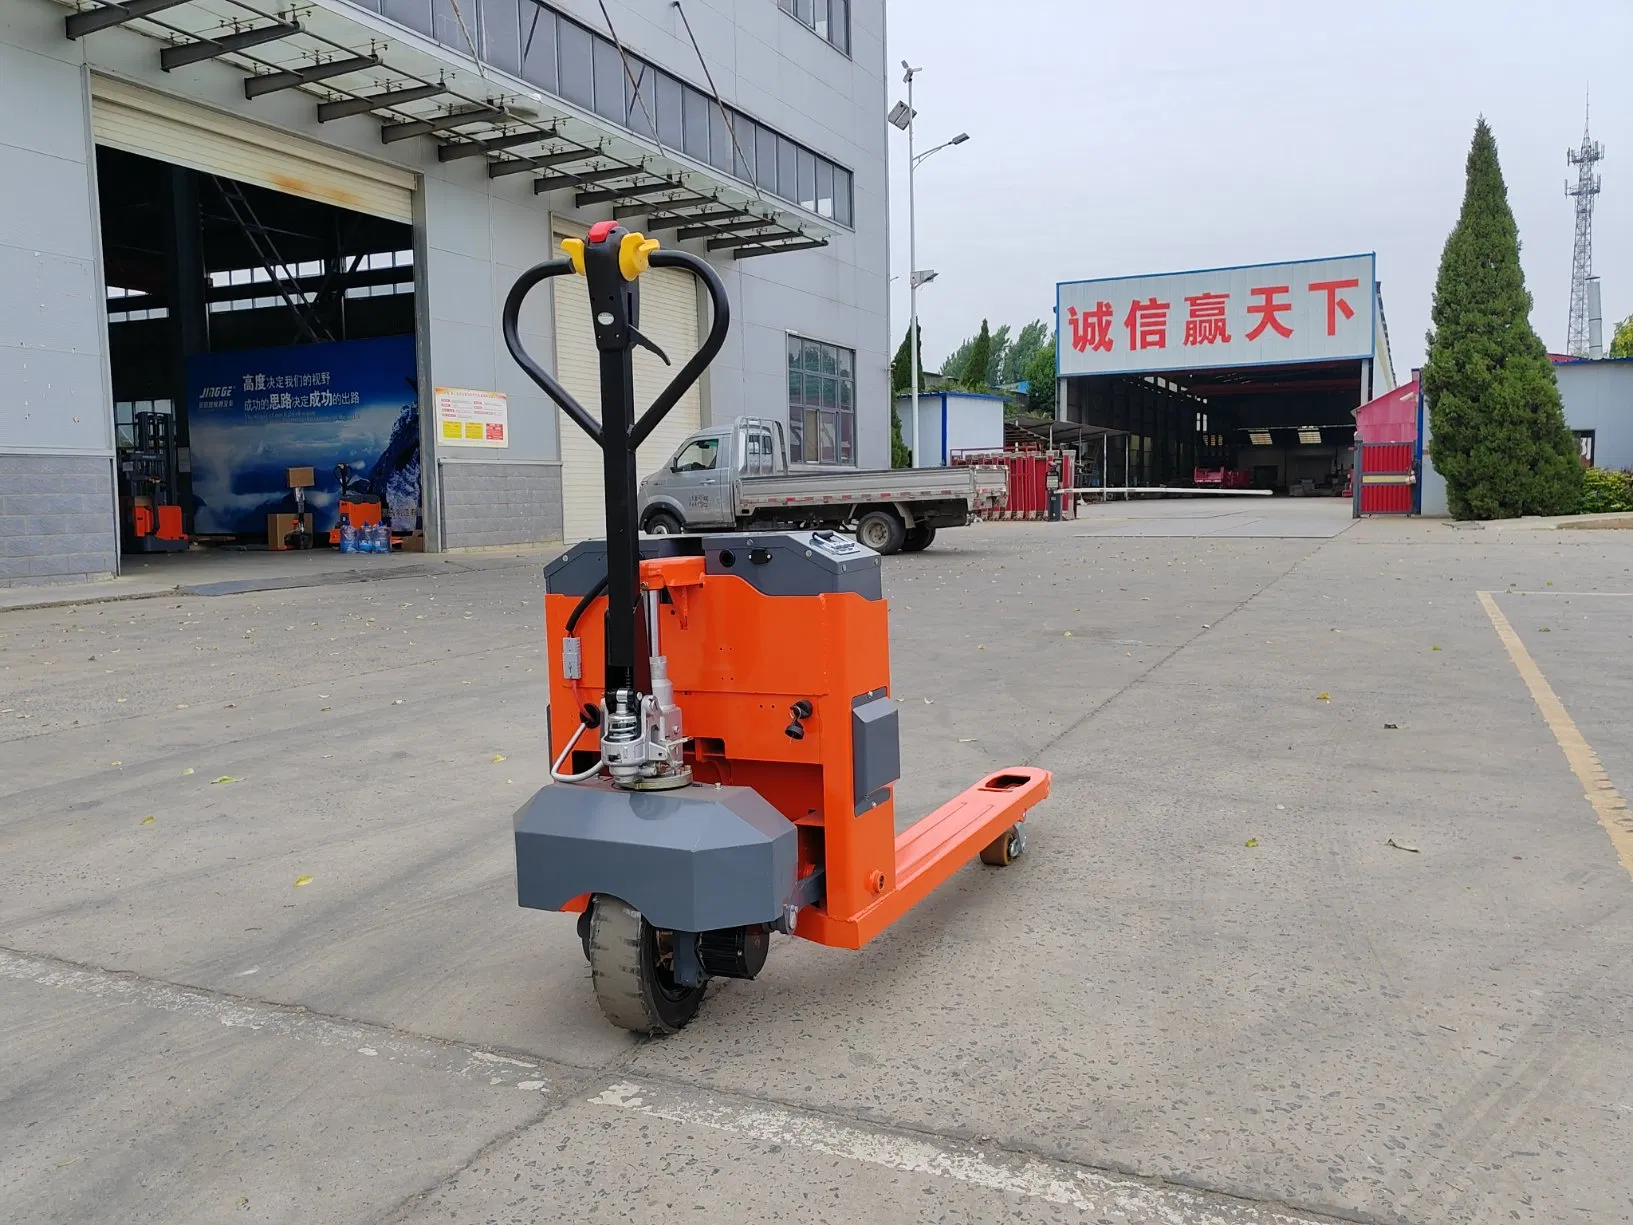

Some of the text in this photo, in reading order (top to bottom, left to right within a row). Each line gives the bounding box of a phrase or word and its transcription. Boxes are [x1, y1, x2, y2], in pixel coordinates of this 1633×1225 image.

[1067, 279, 1359, 352] 诚信赢天下
[243, 372, 330, 391] 高度决定我们的视野
[245, 390, 359, 411] 成功的思路决定成功的出路
